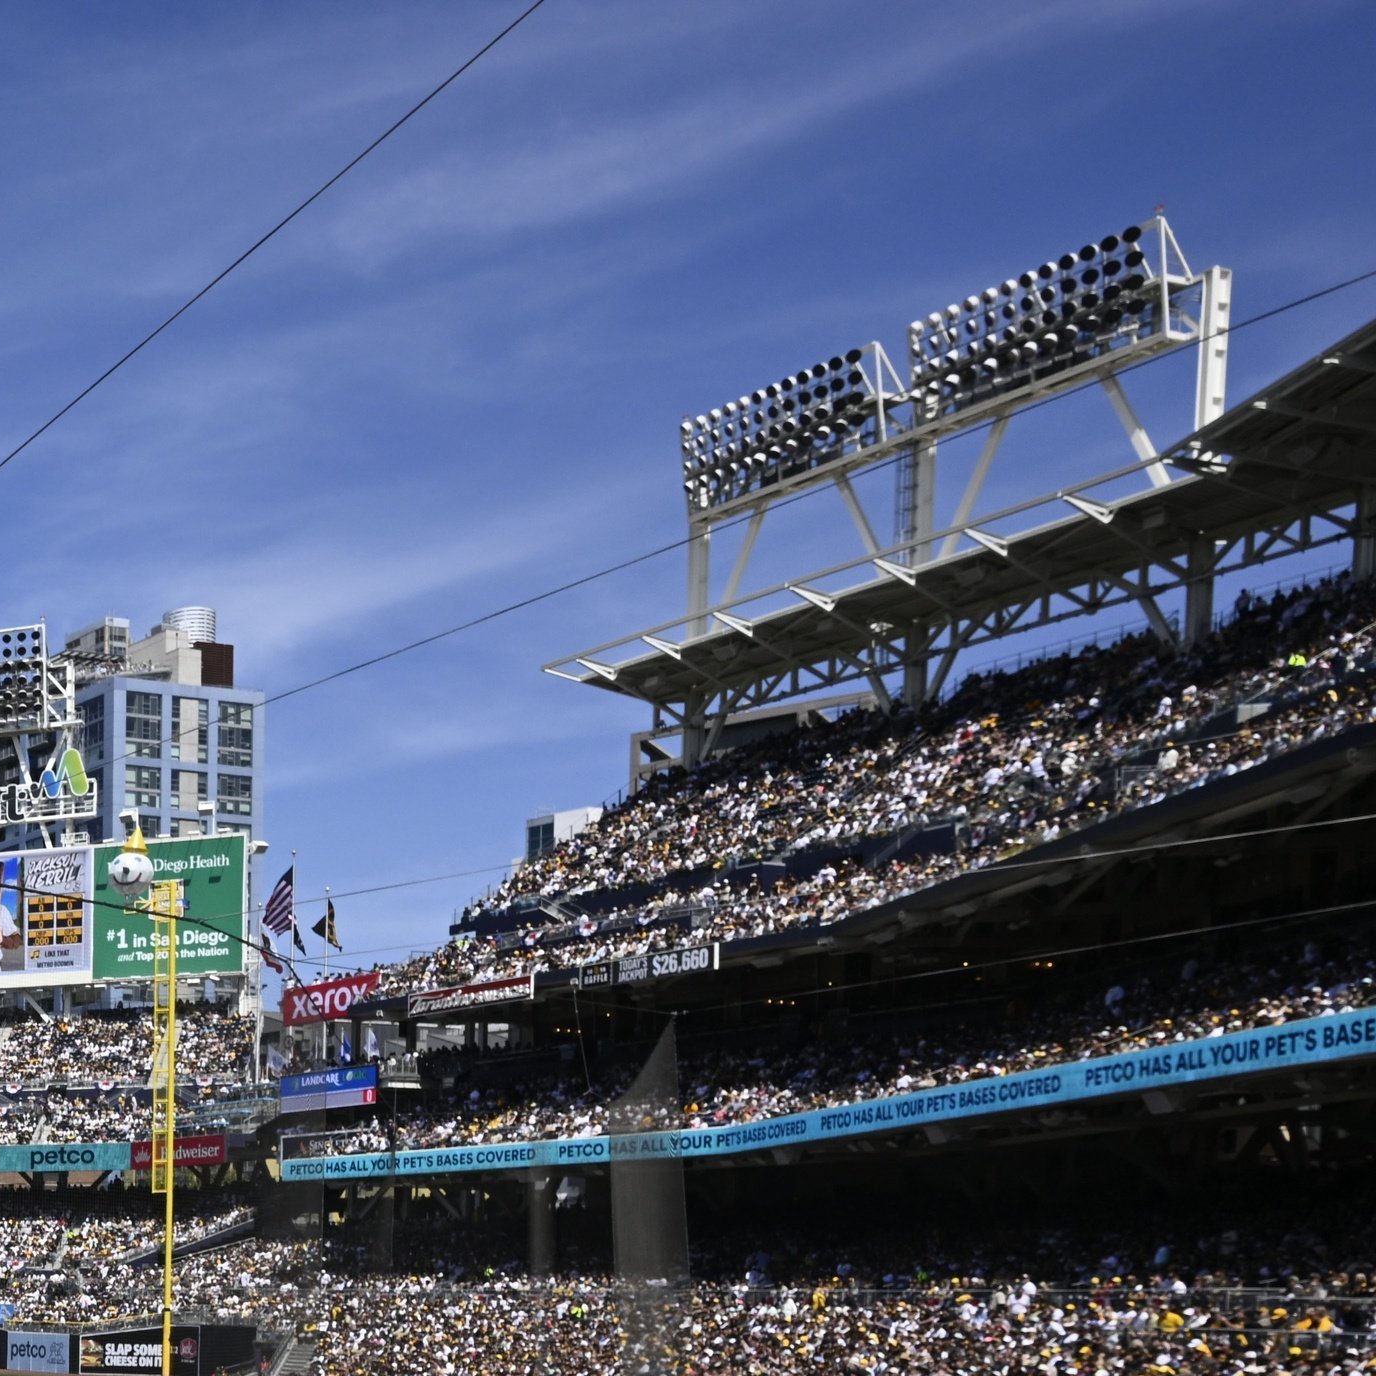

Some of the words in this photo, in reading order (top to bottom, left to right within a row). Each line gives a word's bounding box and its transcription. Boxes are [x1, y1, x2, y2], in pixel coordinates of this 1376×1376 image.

[154, 858, 188, 873] Diego
[189, 854, 230, 869] Health
[107, 929, 128, 949] #1
[133, 934, 147, 947] in
[183, 930, 229, 946] Diego
[136, 952, 154, 962] Top
[180, 949, 196, 958] the
[198, 947, 229, 957] Nation
[618, 956, 647, 971] TODAY'S
[618, 968, 647, 983] JACKPOT
[652, 947, 709, 977] $26,660
[291, 982, 369, 1020] xerox
[1085, 1061, 1135, 1087] PETCO
[1140, 1055, 1172, 1077] HAS
[1175, 1050, 1207, 1073] ALL
[1210, 1039, 1260, 1066] YOUR
[1265, 1029, 1317, 1058] PET'S
[301, 1072, 340, 1087] LANDCARE
[30, 1146, 95, 1170] petco
[289, 1163, 323, 1175] PETCO
[326, 1161, 347, 1173] HAS
[349, 1159, 368, 1171] ALL
[371, 1157, 401, 1170] YOUR
[403, 1155, 434, 1168] PET'S
[437, 1153, 474, 1167] BASES
[476, 1148, 536, 1164] COVERED
[10, 1340, 47, 1361] petco
[105, 1343, 133, 1356] SLAP
[133, 1343, 163, 1356] SOME
[105, 1356, 138, 1367] CHEESE
[139, 1357, 153, 1367] ON
